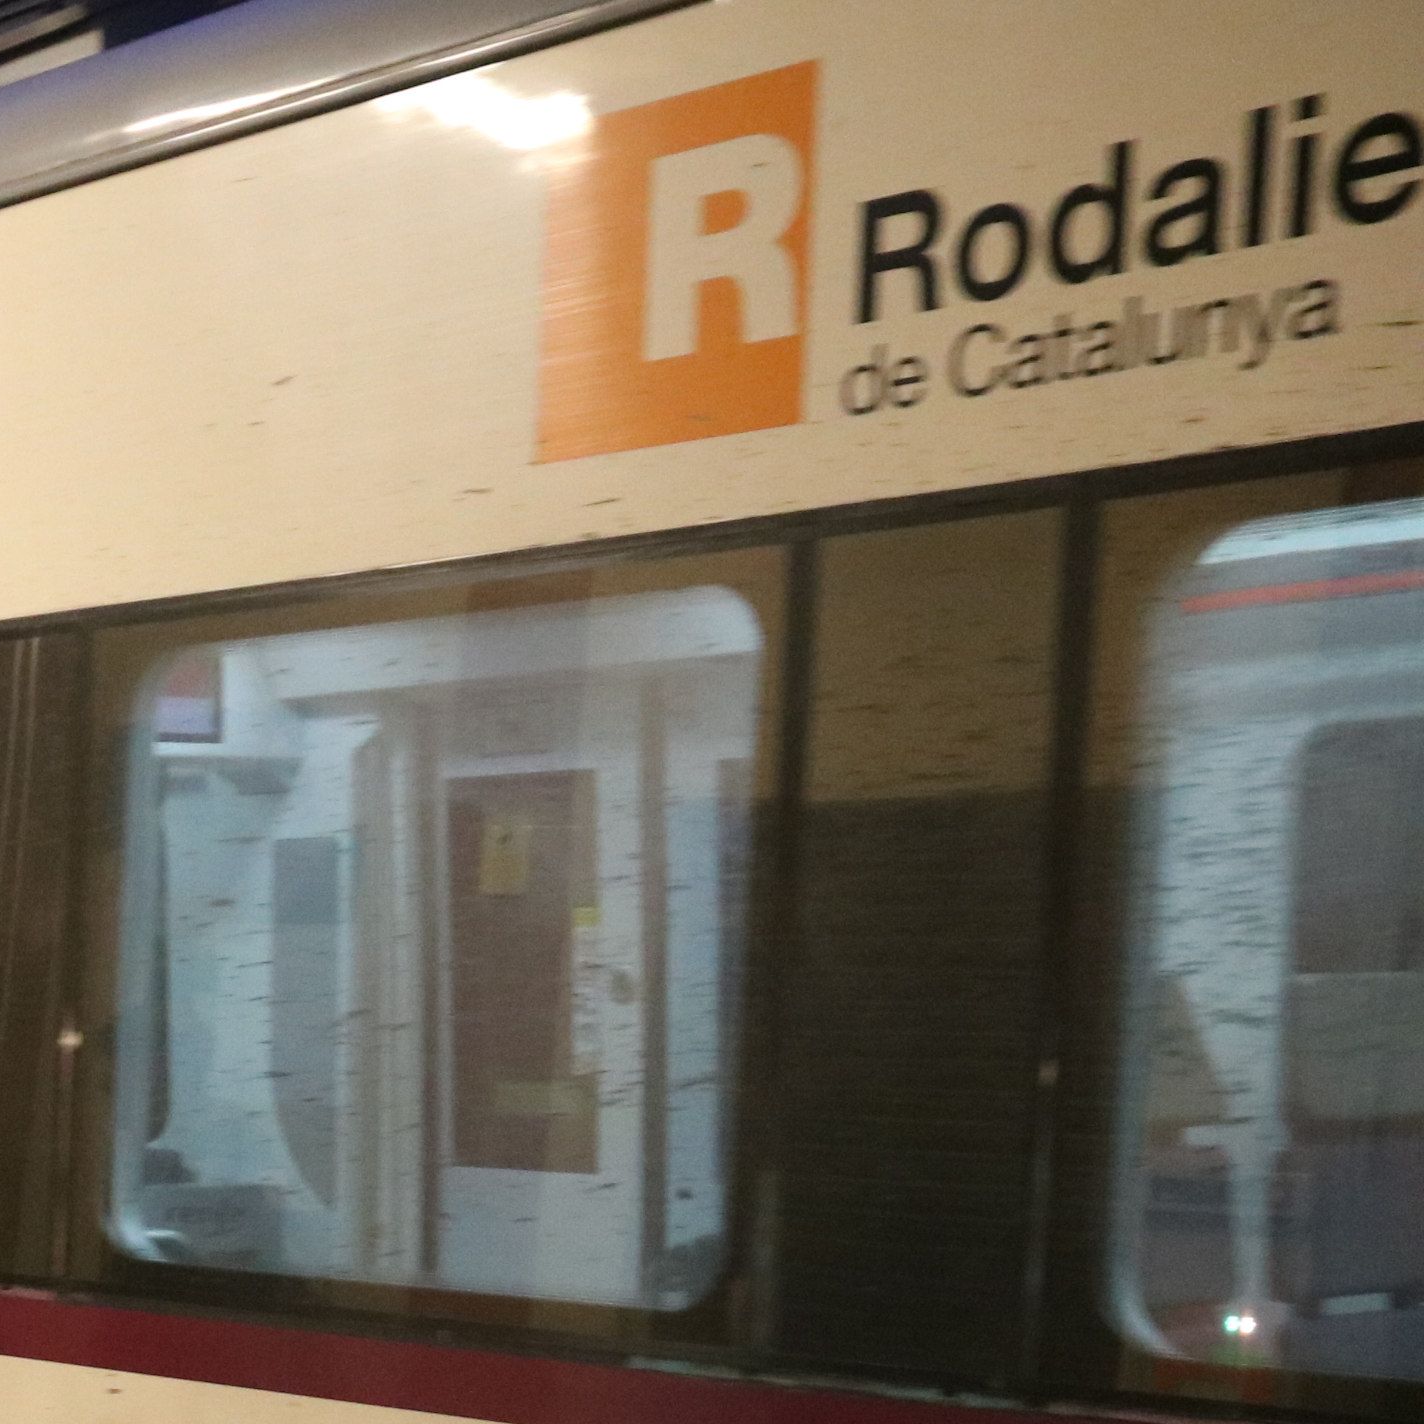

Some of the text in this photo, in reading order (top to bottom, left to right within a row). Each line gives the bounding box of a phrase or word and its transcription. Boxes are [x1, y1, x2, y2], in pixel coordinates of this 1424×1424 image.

[644, 133, 803, 362] R
[854, 94, 1424, 324] Rodalie
[839, 278, 1340, 416] de Catalunya
